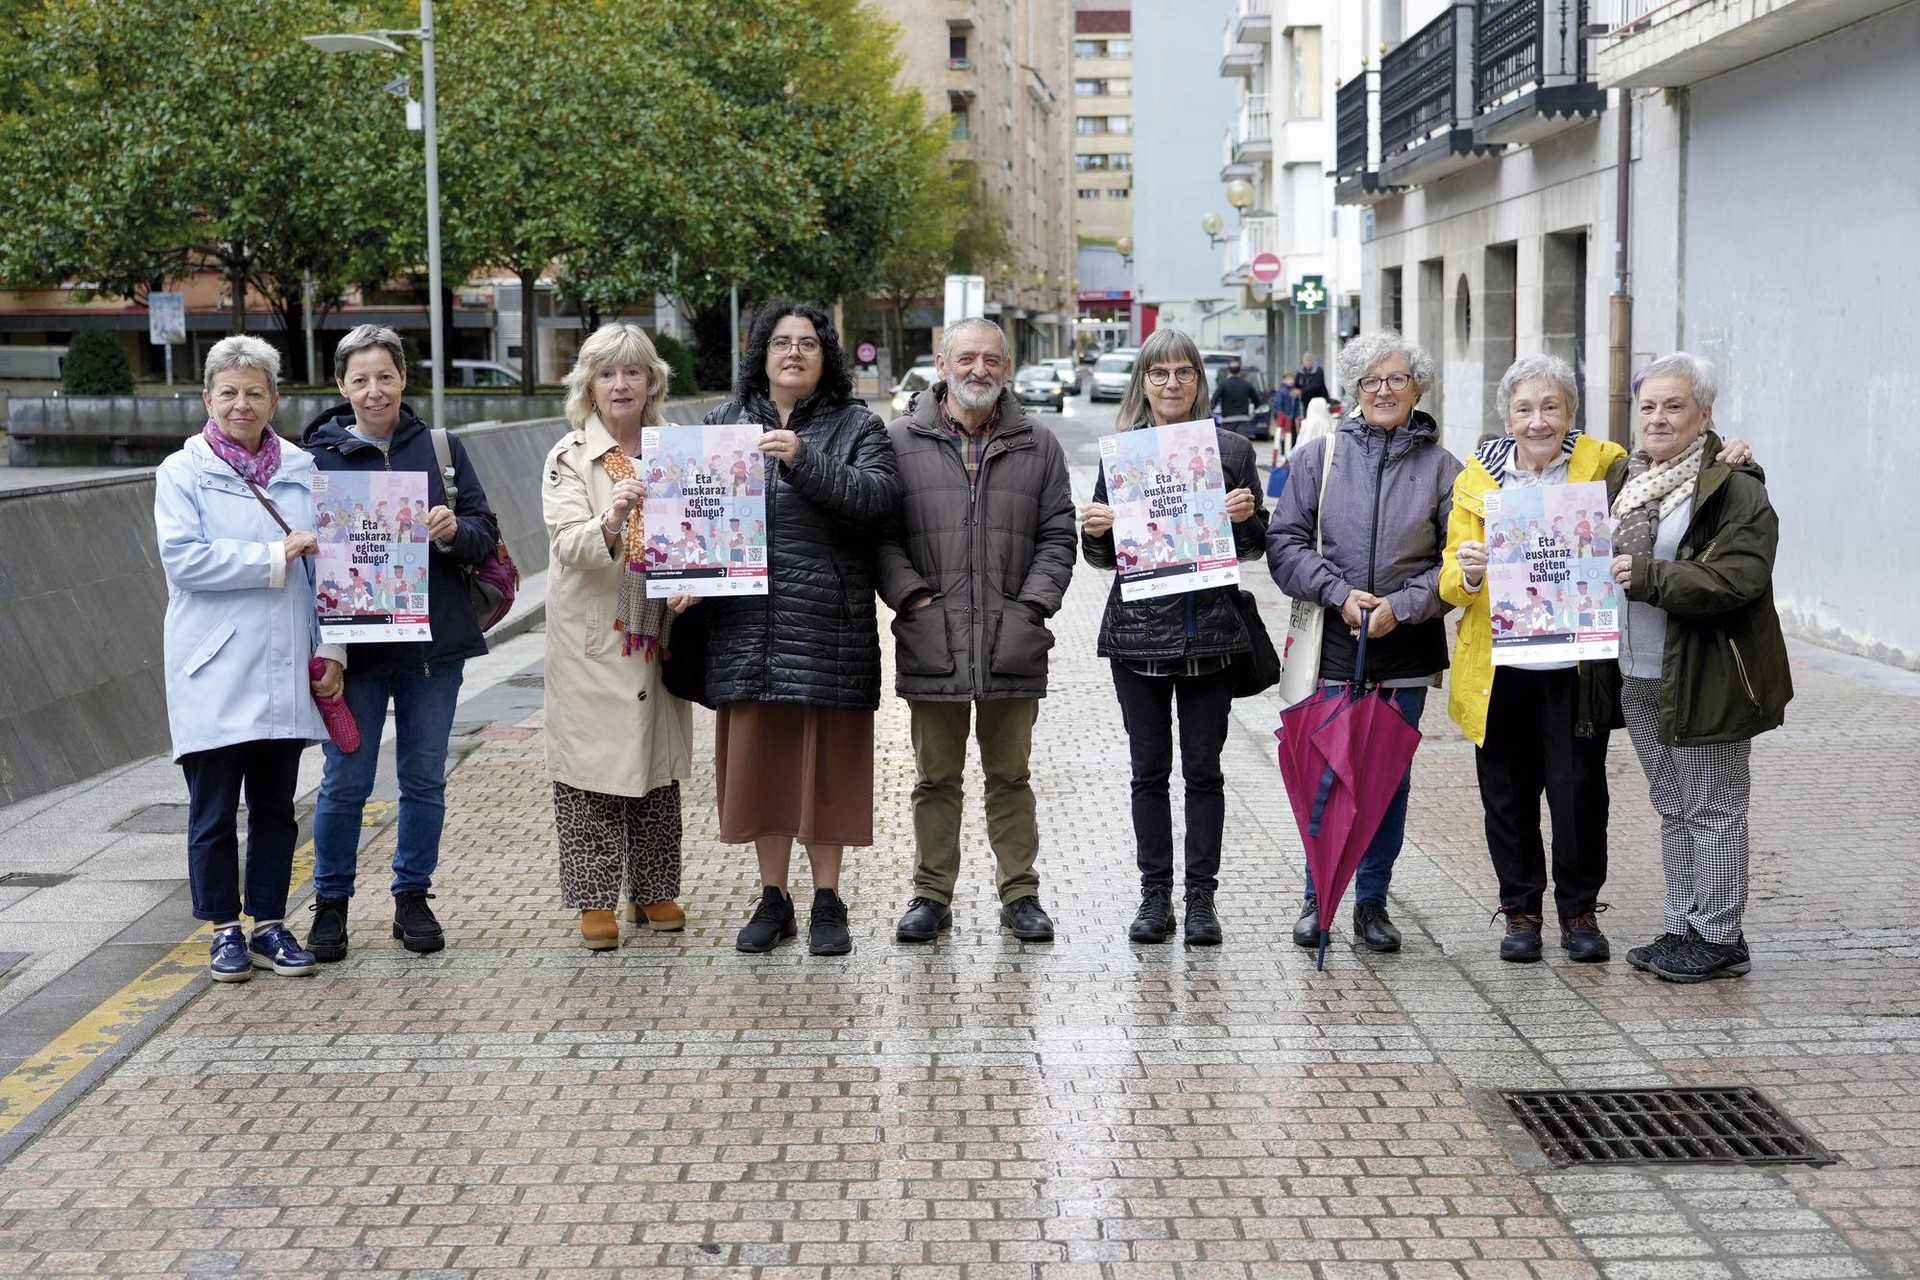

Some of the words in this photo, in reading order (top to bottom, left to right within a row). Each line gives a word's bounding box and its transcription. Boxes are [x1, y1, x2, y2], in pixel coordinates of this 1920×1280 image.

[695, 474, 712, 484] Eta
[1156, 474, 1172, 485] Eta
[682, 485, 726, 496] euskaraz
[1144, 484, 1187, 498] euskaraz
[689, 496, 720, 509] egiten
[1152, 495, 1183, 509] egiten
[685, 507, 725, 520] badugu?
[1149, 503, 1187, 519] badugu?
[362, 520, 378, 530] Eta
[350, 531, 392, 541] euskaraz
[1539, 537, 1556, 547] Eta
[356, 542, 385, 555] egiten
[1525, 548, 1571, 560] euskaraz
[352, 553, 389, 566] badugu?
[1533, 559, 1566, 573] egiten
[1530, 570, 1571, 584] badugu?
